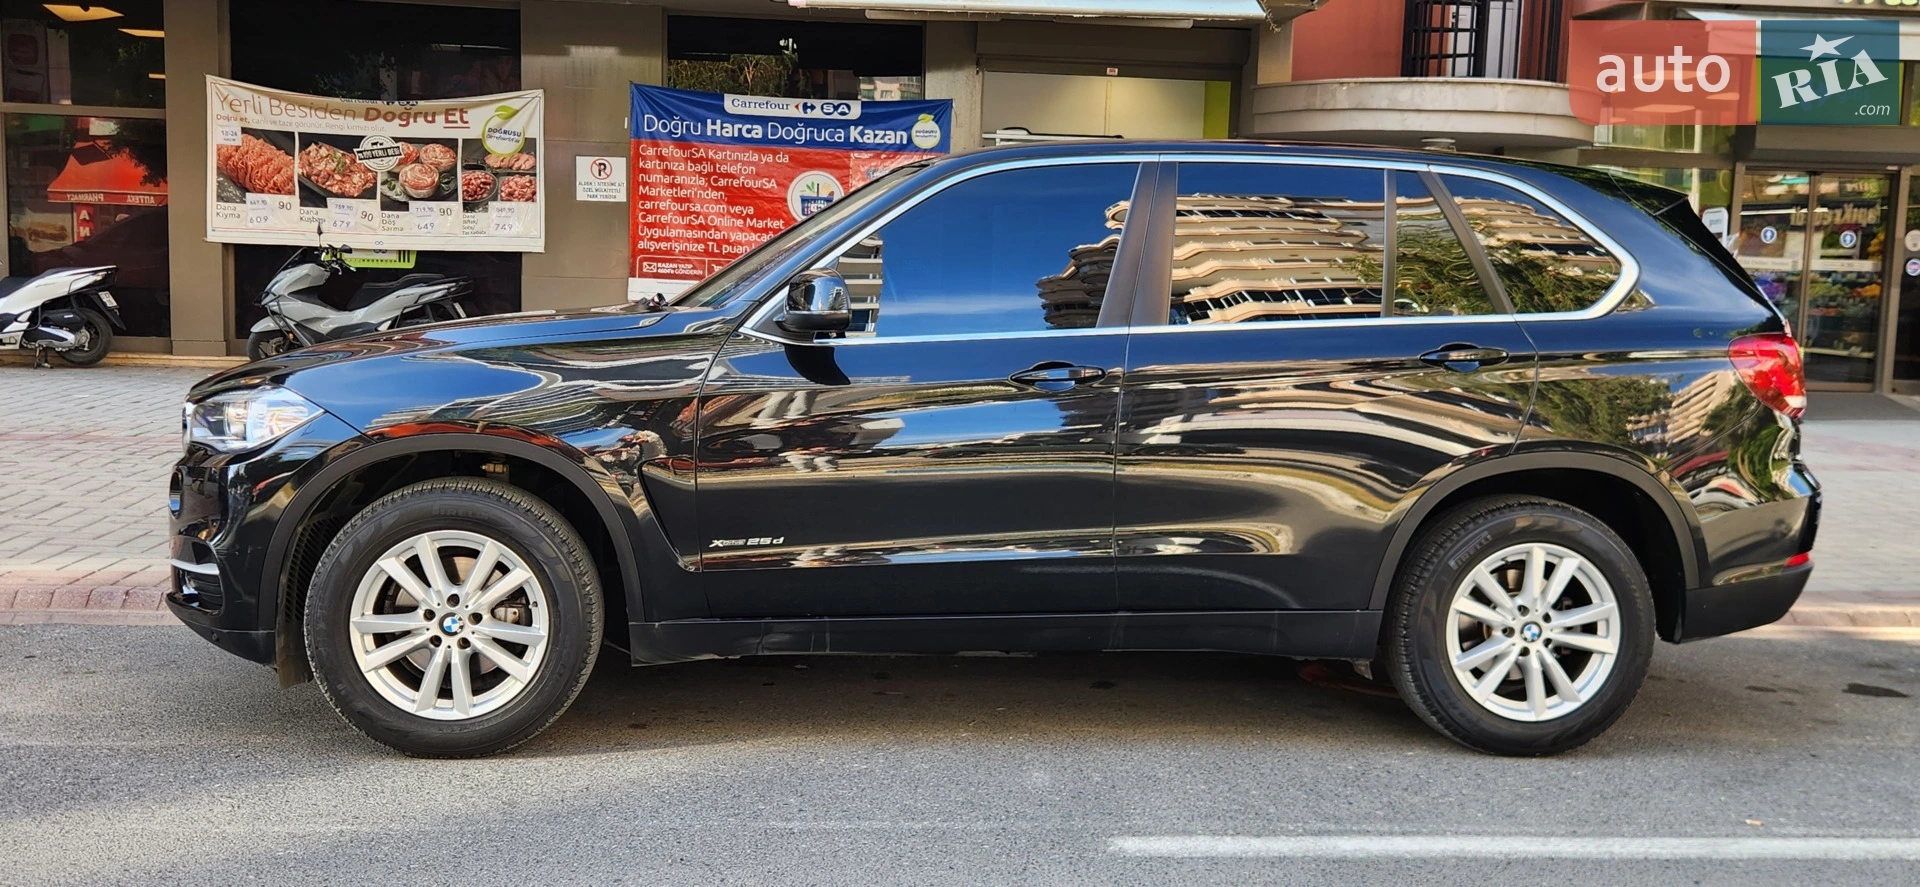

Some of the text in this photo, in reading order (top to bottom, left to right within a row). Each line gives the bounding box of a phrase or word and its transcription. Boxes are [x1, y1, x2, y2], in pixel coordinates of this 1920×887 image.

[216, 91, 469, 127] Yerli Besiden Doğru Et
[732, 98, 850, 114] Carrefour SA
[279, 119, 293, 127] taze
[326, 122, 345, 131] Rengi
[488, 127, 521, 137] DOĞRUSU
[644, 114, 908, 145] Doğru Harca Doğruca Kazan
[639, 144, 789, 164] CarrefourSA Kartınızla ya da
[639, 158, 756, 174] kartınıza bağlı telefon
[639, 173, 777, 189] numaranızla; CarrefourSA
[638, 185, 728, 202] Marketleri'nden,
[216, 203, 236, 211] Dana
[278, 200, 292, 211] 90
[439, 207, 452, 217] 90
[638, 200, 754, 217] carrefoursa.com veya
[216, 211, 240, 219] Kıyma
[360, 210, 374, 222] 90
[638, 212, 785, 229] CarrefourSA Online Market
[332, 220, 351, 228] 679
[417, 222, 435, 230] 649
[495, 223, 513, 231] 749
[638, 226, 728, 240] Uygulamasından
[638, 238, 705, 253] alışverişinize
[707, 242, 719, 252] TL
[722, 244, 750, 255] puan
